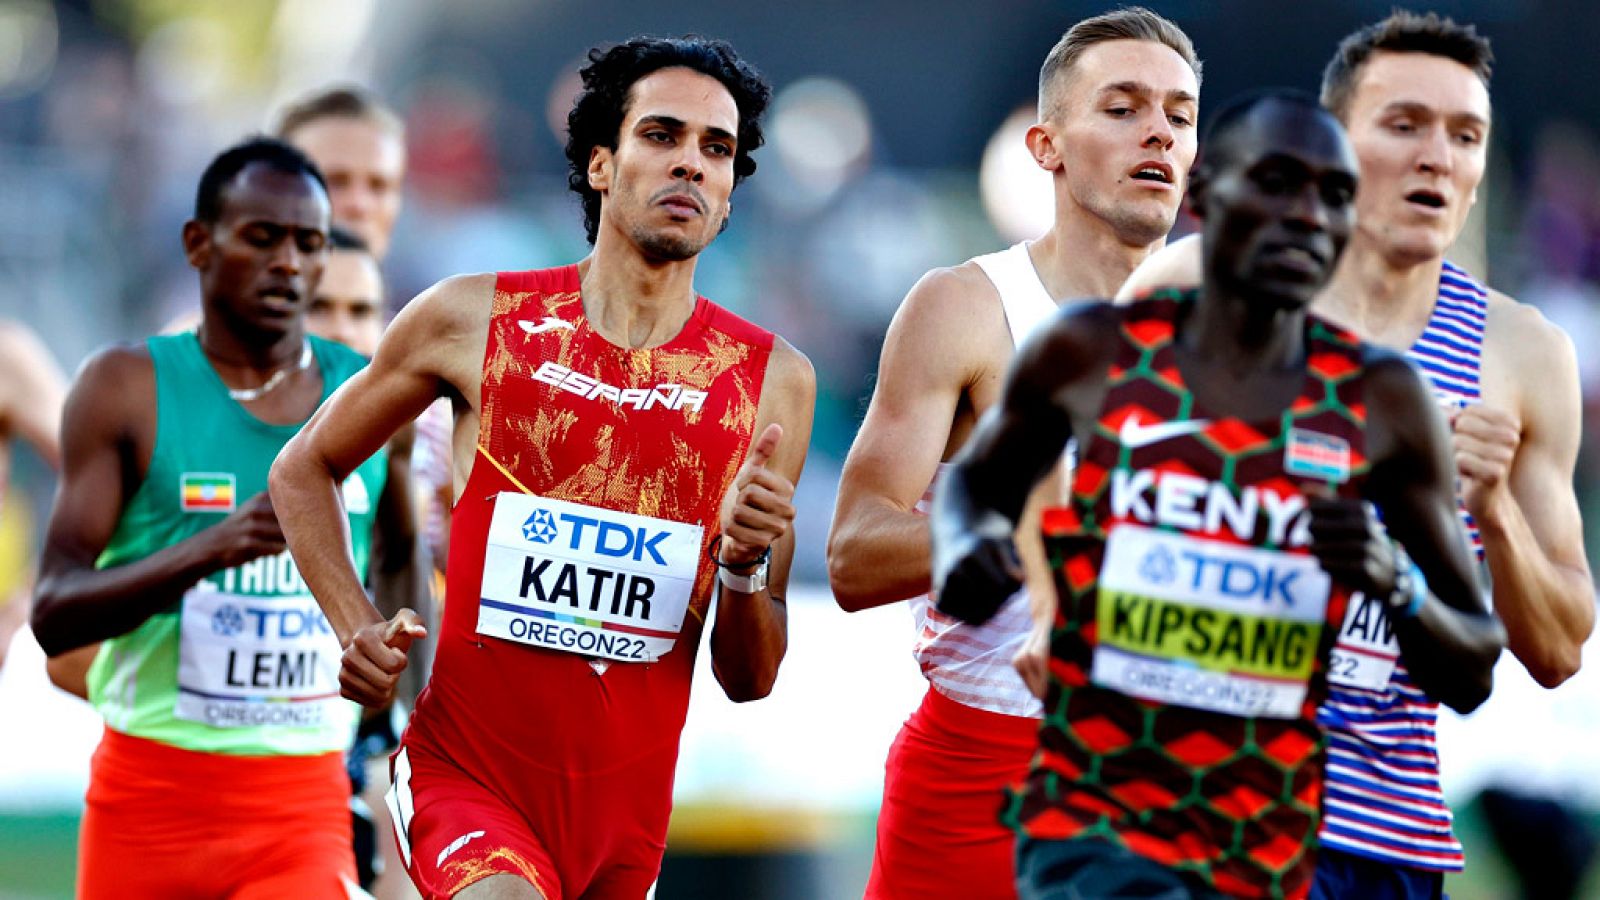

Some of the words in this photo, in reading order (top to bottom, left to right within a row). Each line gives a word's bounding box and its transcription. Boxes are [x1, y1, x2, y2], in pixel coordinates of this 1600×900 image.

[531, 361, 709, 412] ESPAÑA
[560, 513, 673, 567] TDK
[196, 549, 312, 593] THIO
[519, 555, 656, 621] KATIR
[1182, 551, 1300, 608] TDK
[246, 607, 329, 640] TDK
[509, 618, 646, 660] OREGON22
[1112, 596, 1311, 673] KIPSANG
[1346, 597, 1396, 645] AN
[225, 649, 318, 689] LEMI
[1330, 654, 1360, 679] 22
